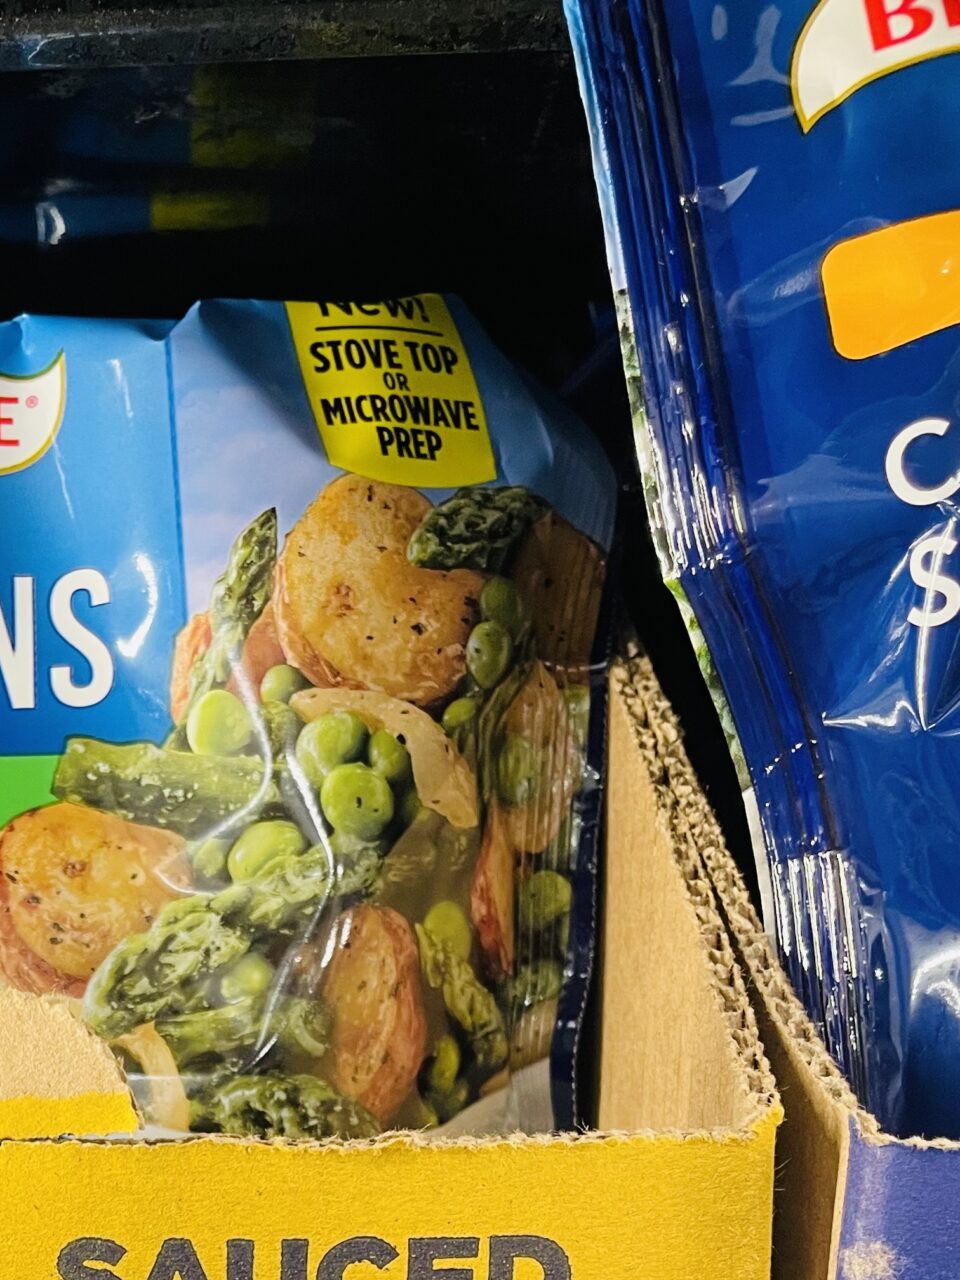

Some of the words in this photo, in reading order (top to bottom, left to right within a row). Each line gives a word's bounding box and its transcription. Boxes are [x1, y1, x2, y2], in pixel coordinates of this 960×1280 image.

[309, 339, 403, 373] STOVE
[403, 341, 458, 375] TOP
[383, 372, 411, 391] OR
[320, 394, 480, 431] MICROWAVE
[376, 426, 443, 461] PREP
